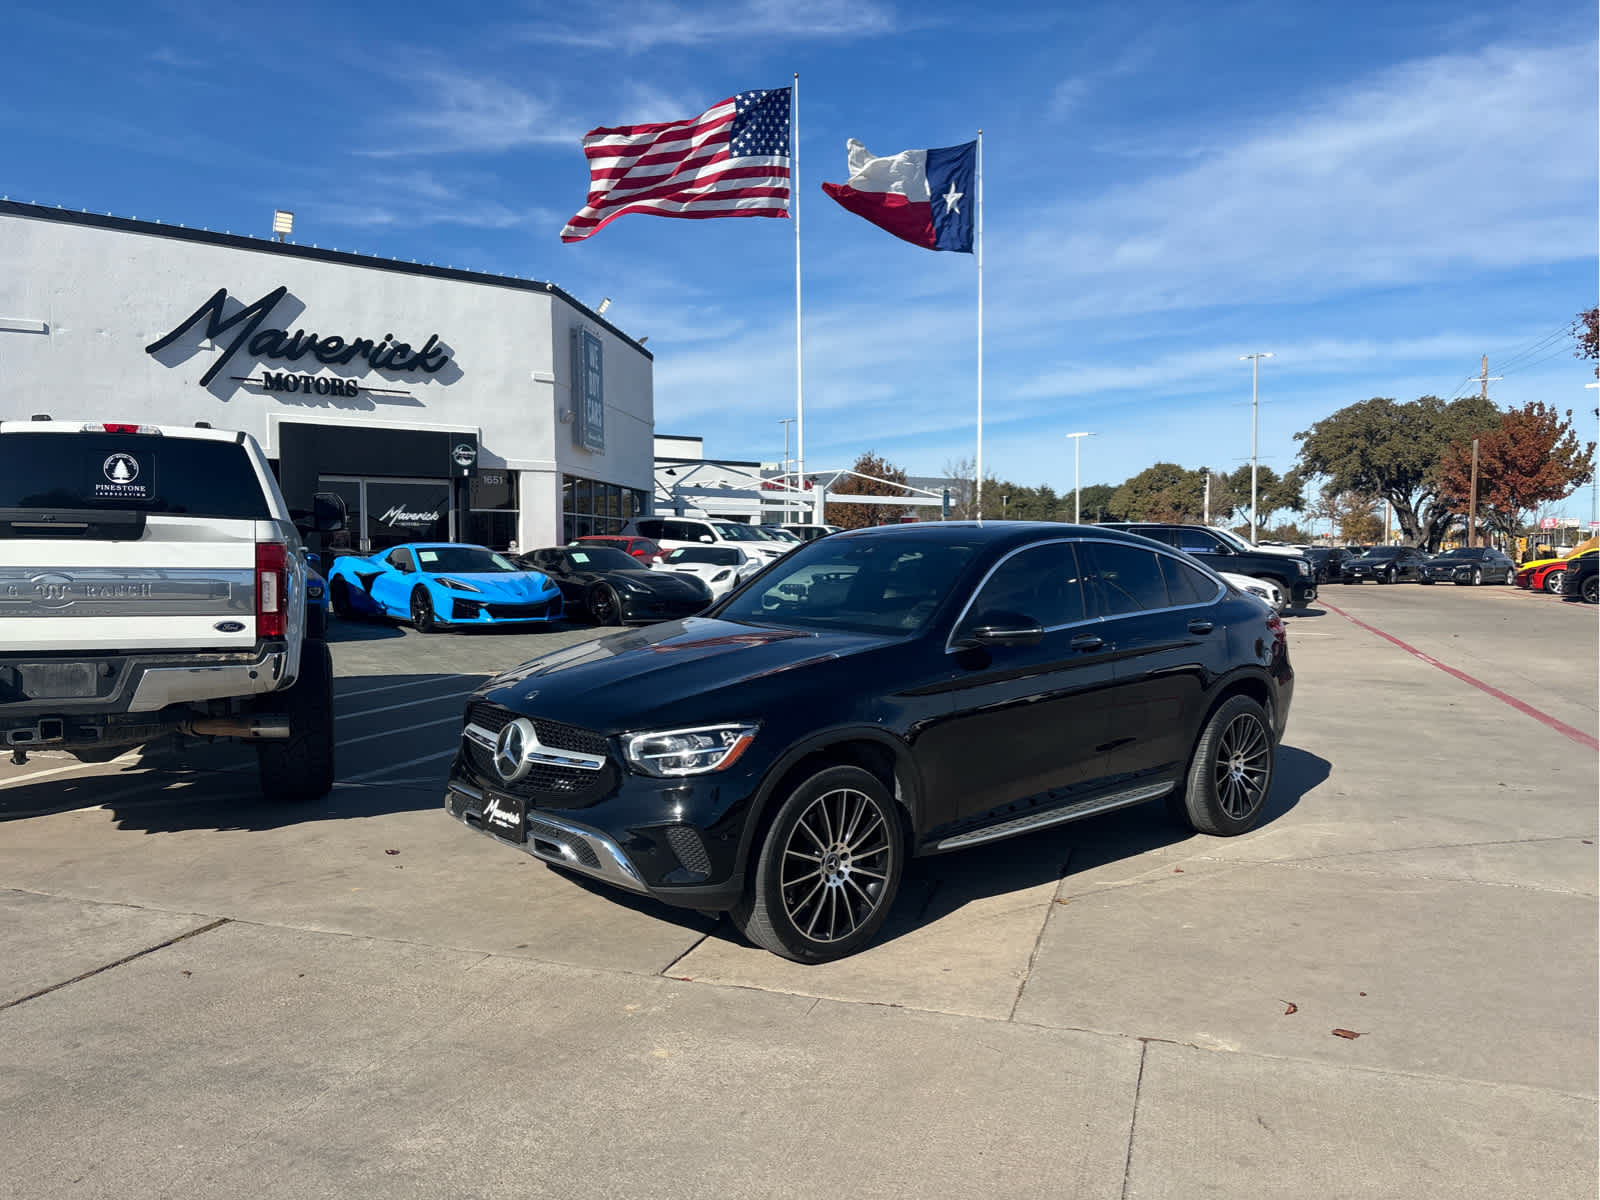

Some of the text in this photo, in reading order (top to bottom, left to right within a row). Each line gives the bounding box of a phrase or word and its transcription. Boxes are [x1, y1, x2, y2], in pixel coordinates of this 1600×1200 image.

[145, 285, 449, 387] Maverick
[262, 371, 360, 398] MOTORS
[95, 484, 147, 492] PINESTONE
[379, 503, 440, 527] Maverick
[85, 583, 153, 598] RANCH
